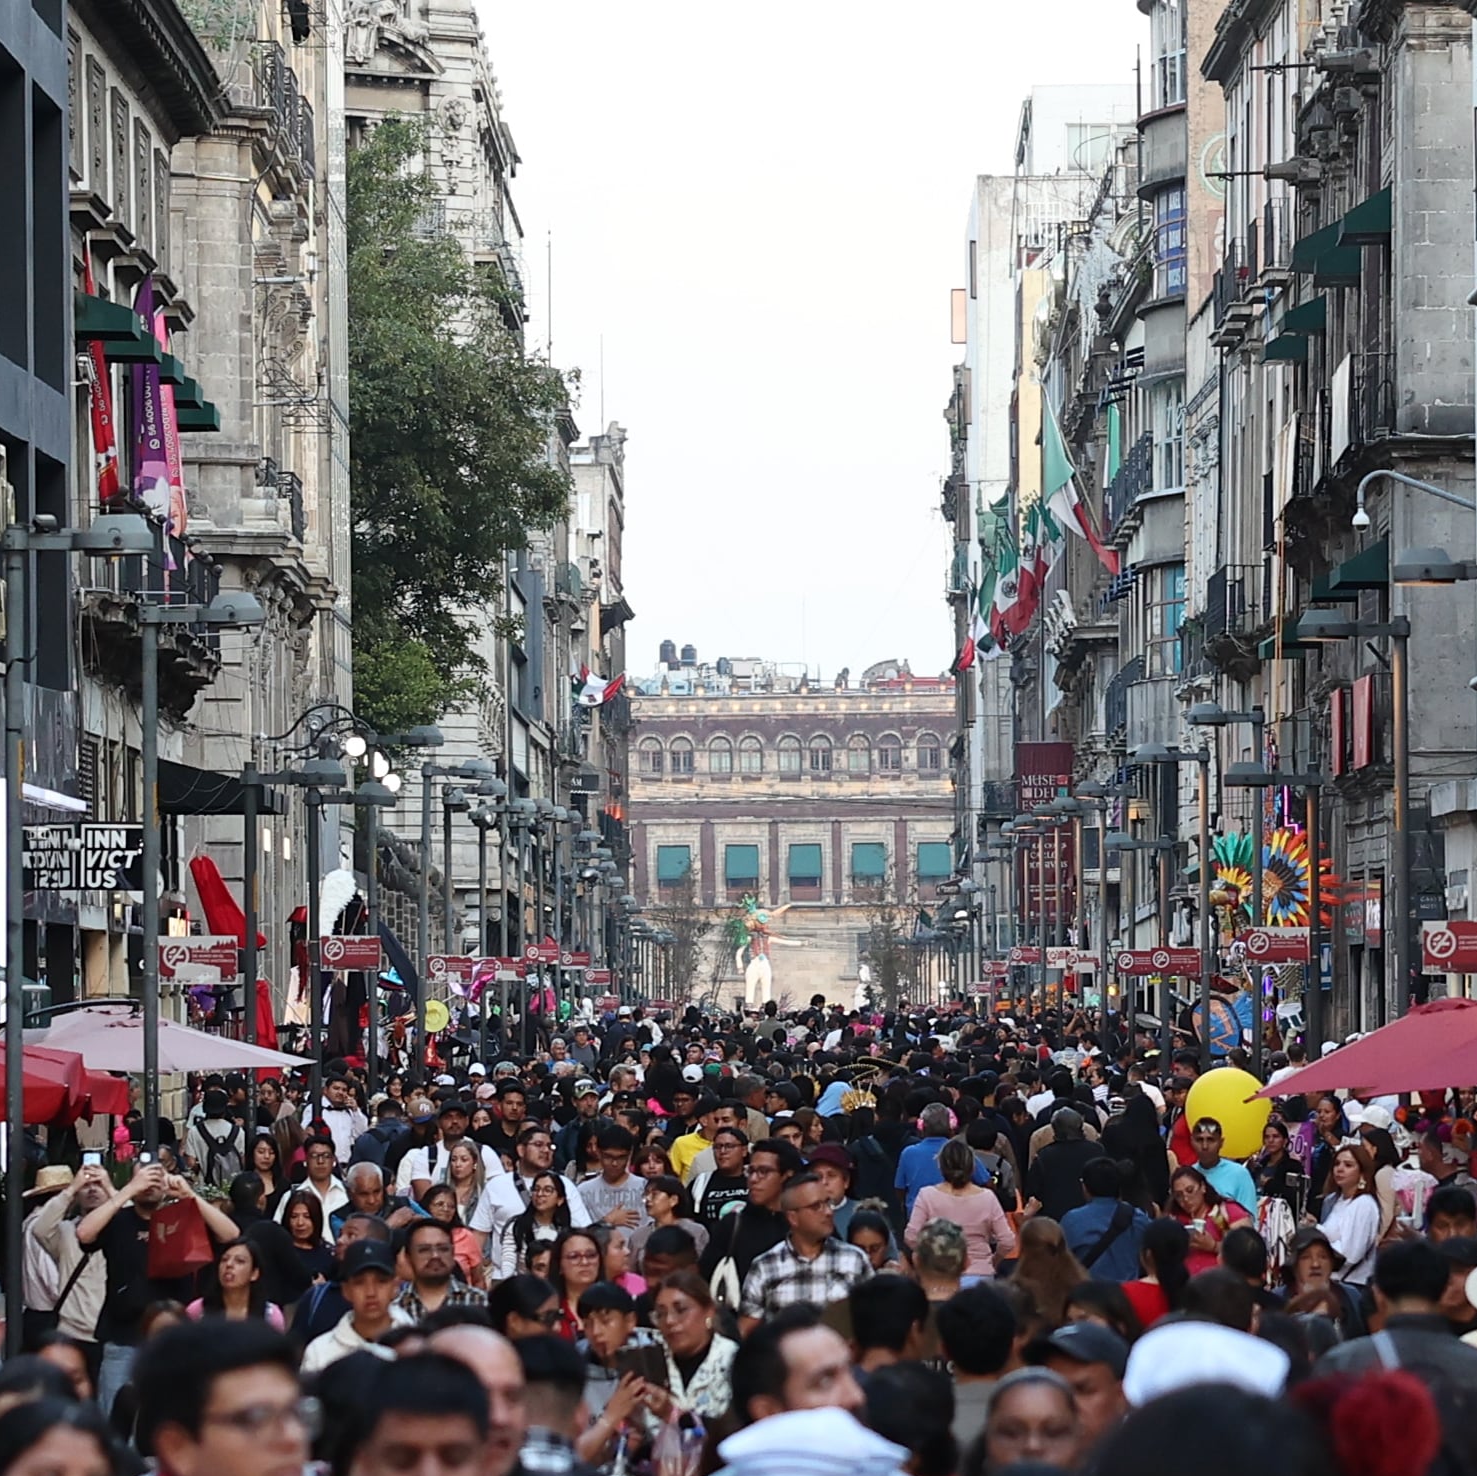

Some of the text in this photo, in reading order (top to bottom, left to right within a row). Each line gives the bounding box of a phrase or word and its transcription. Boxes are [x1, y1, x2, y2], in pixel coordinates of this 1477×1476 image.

[87, 830, 126, 849] INN
[87, 850, 138, 869] VICT
[87, 870, 117, 888] US
